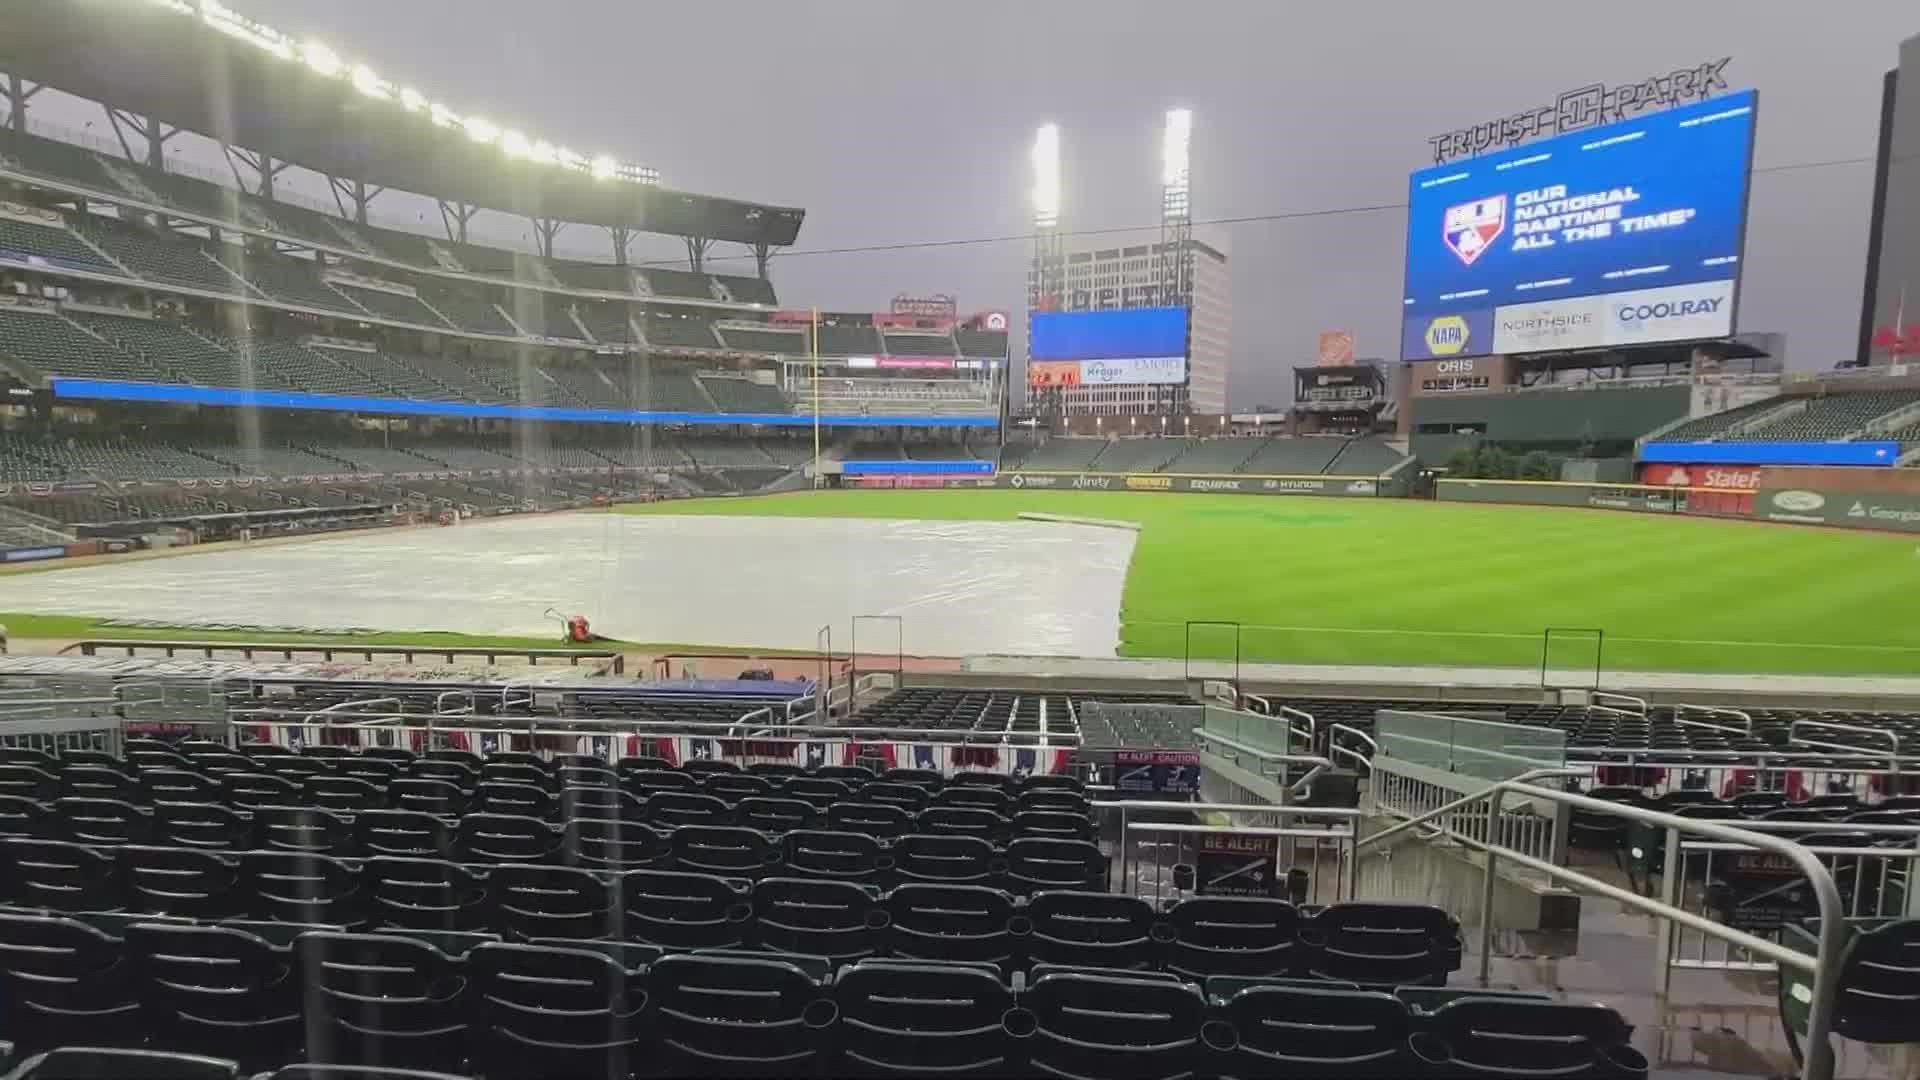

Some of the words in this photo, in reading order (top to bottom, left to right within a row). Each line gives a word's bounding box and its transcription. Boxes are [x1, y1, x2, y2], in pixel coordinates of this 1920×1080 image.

[1428, 106, 1552, 160] TRUIST
[1614, 57, 1731, 113] PARK
[1513, 185, 1641, 220] NATIONAL
[1515, 184, 1567, 205] OUR
[1512, 205, 1622, 237] PASTIME
[1511, 233, 1556, 251] ALL
[1562, 222, 1612, 243] THE
[1619, 297, 1724, 322] COOLRAY
[1431, 326, 1463, 344] NAPA
[1437, 360, 1473, 372] ORIS
[1704, 469, 1750, 487] State
[1158, 753, 1199, 763] CAUTION
[1204, 839, 1224, 849] BE
[1228, 837, 1272, 851] ALERT
